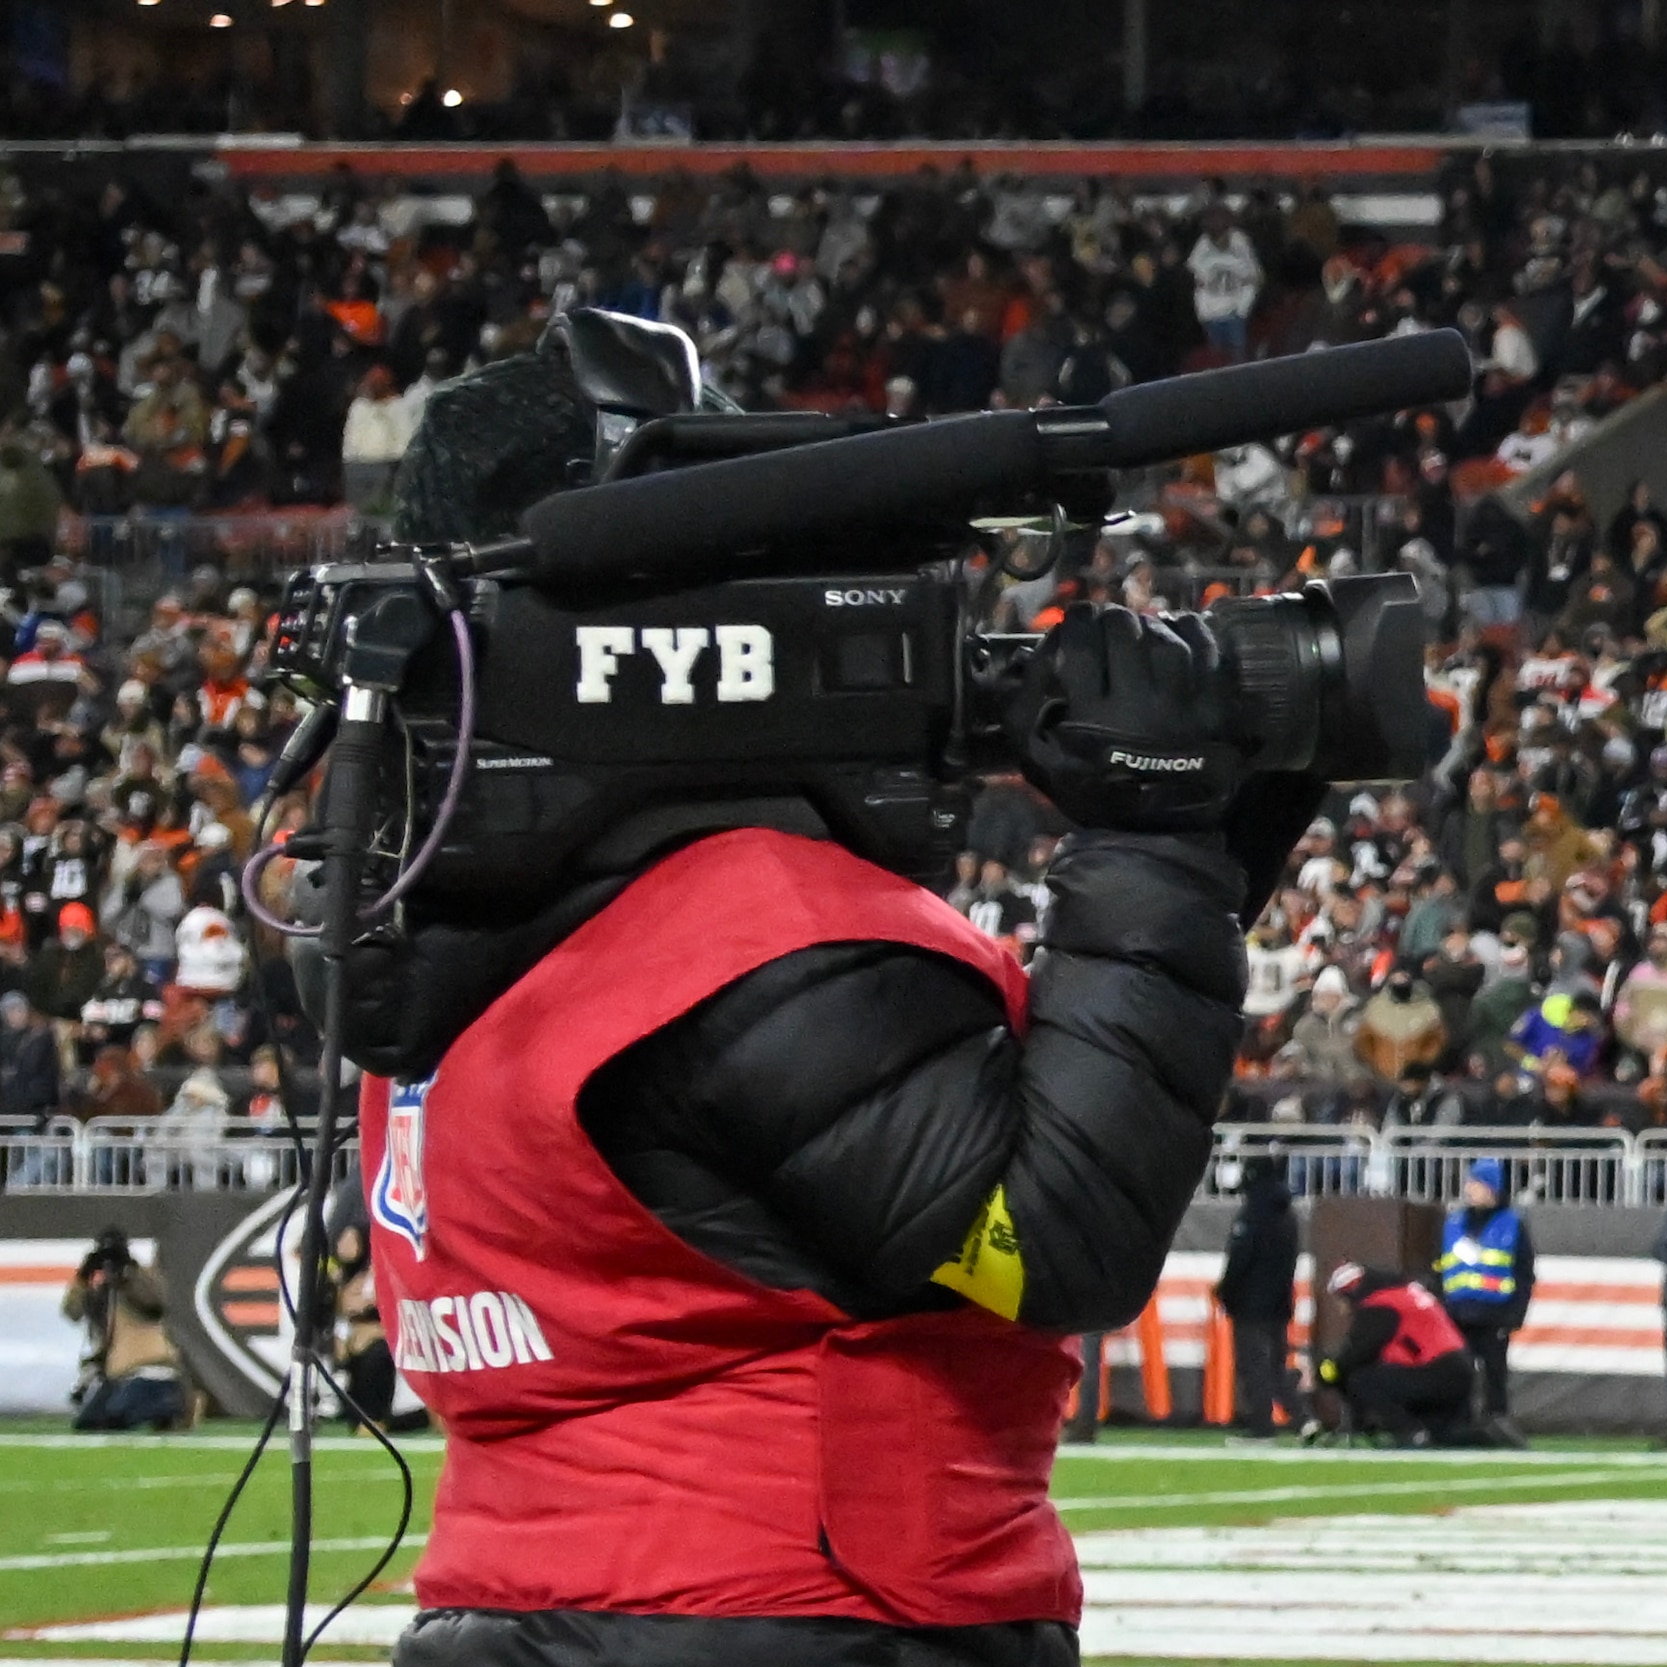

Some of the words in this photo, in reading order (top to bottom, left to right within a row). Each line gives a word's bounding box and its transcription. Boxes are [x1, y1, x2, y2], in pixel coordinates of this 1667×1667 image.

[824, 589, 906, 607] SONY
[576, 625, 775, 704] FYB
[1109, 750, 1205, 772] FUJINON
